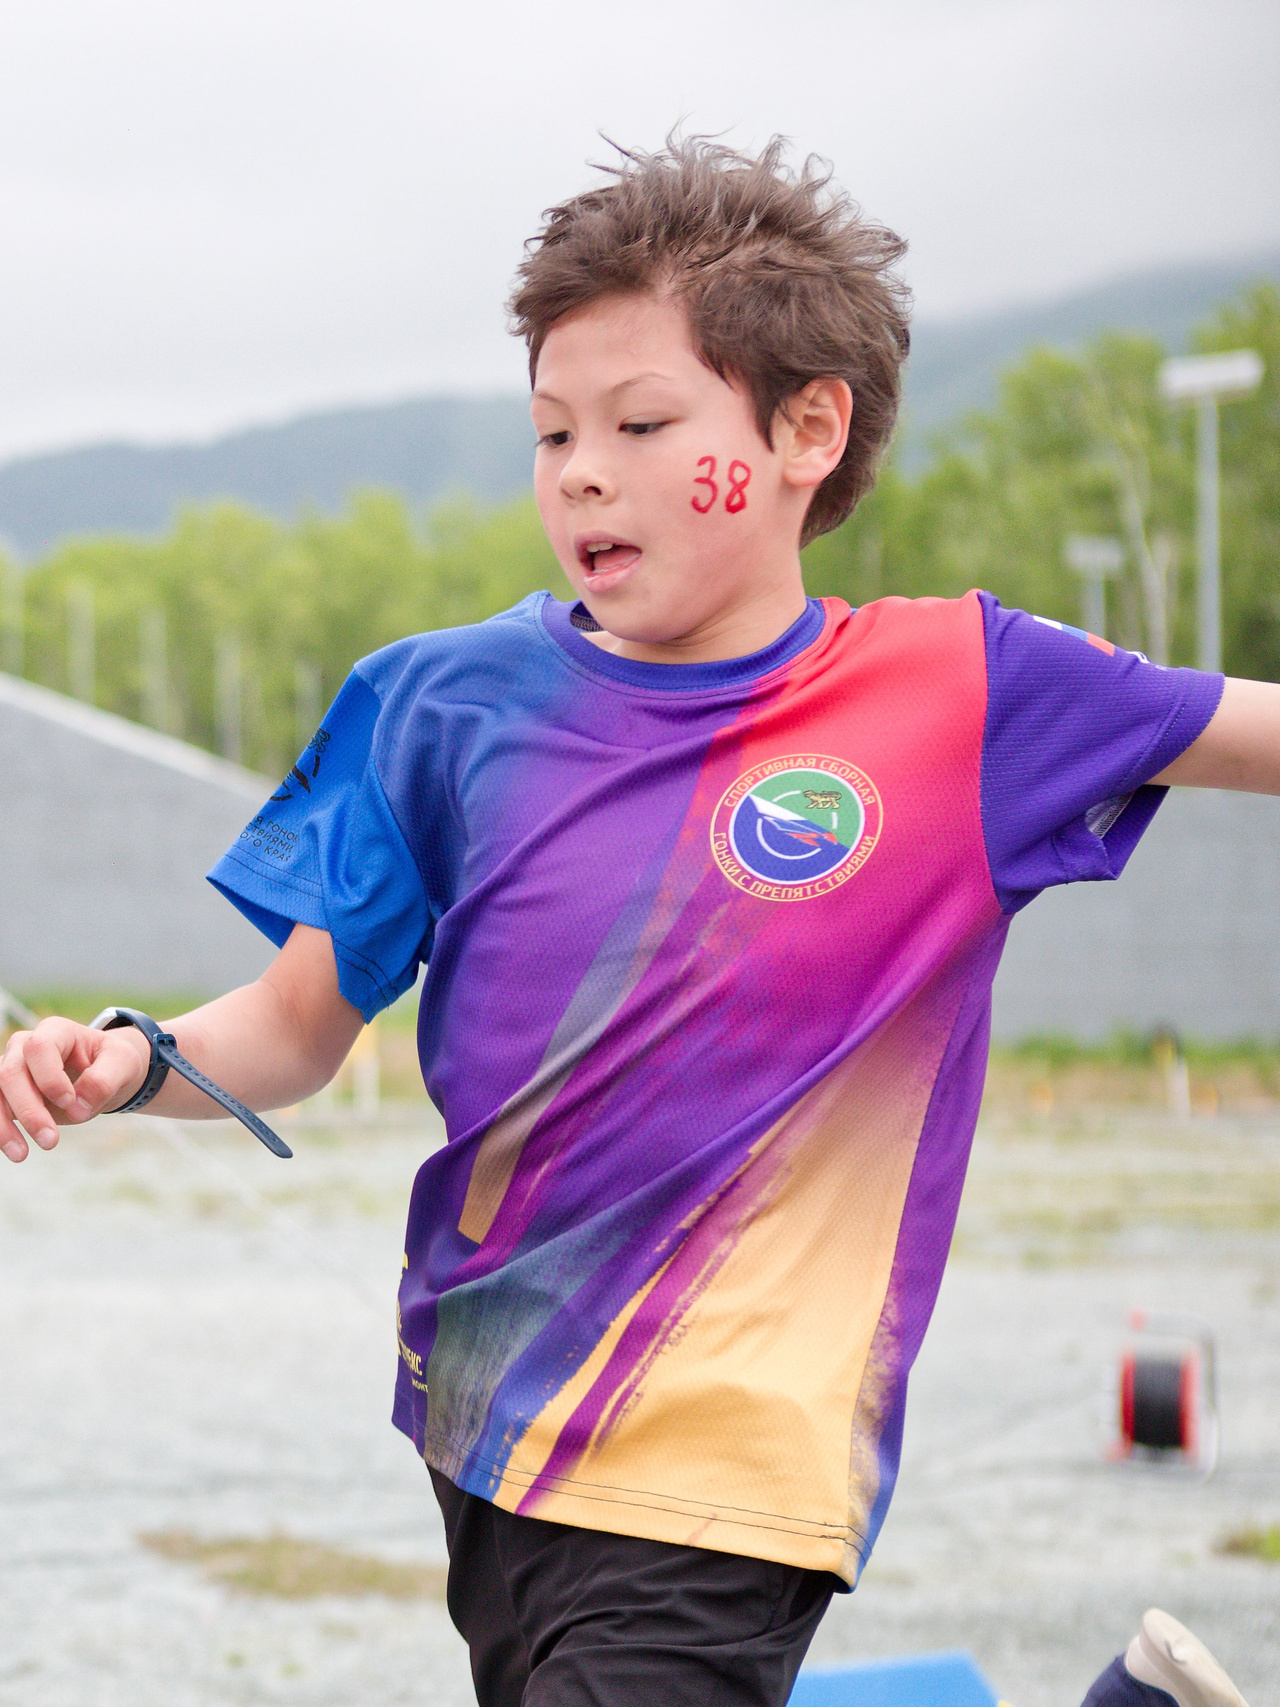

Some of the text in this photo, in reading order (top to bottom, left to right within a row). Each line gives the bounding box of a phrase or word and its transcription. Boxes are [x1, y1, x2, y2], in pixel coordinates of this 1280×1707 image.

[691, 455, 752, 514] 38
[724, 757, 876, 808] СПОРТИВНАЯ СБОРНАЯ
[714, 832, 876, 899] ГОНКИ С ПРЕПЯТСТВИЯМИ
